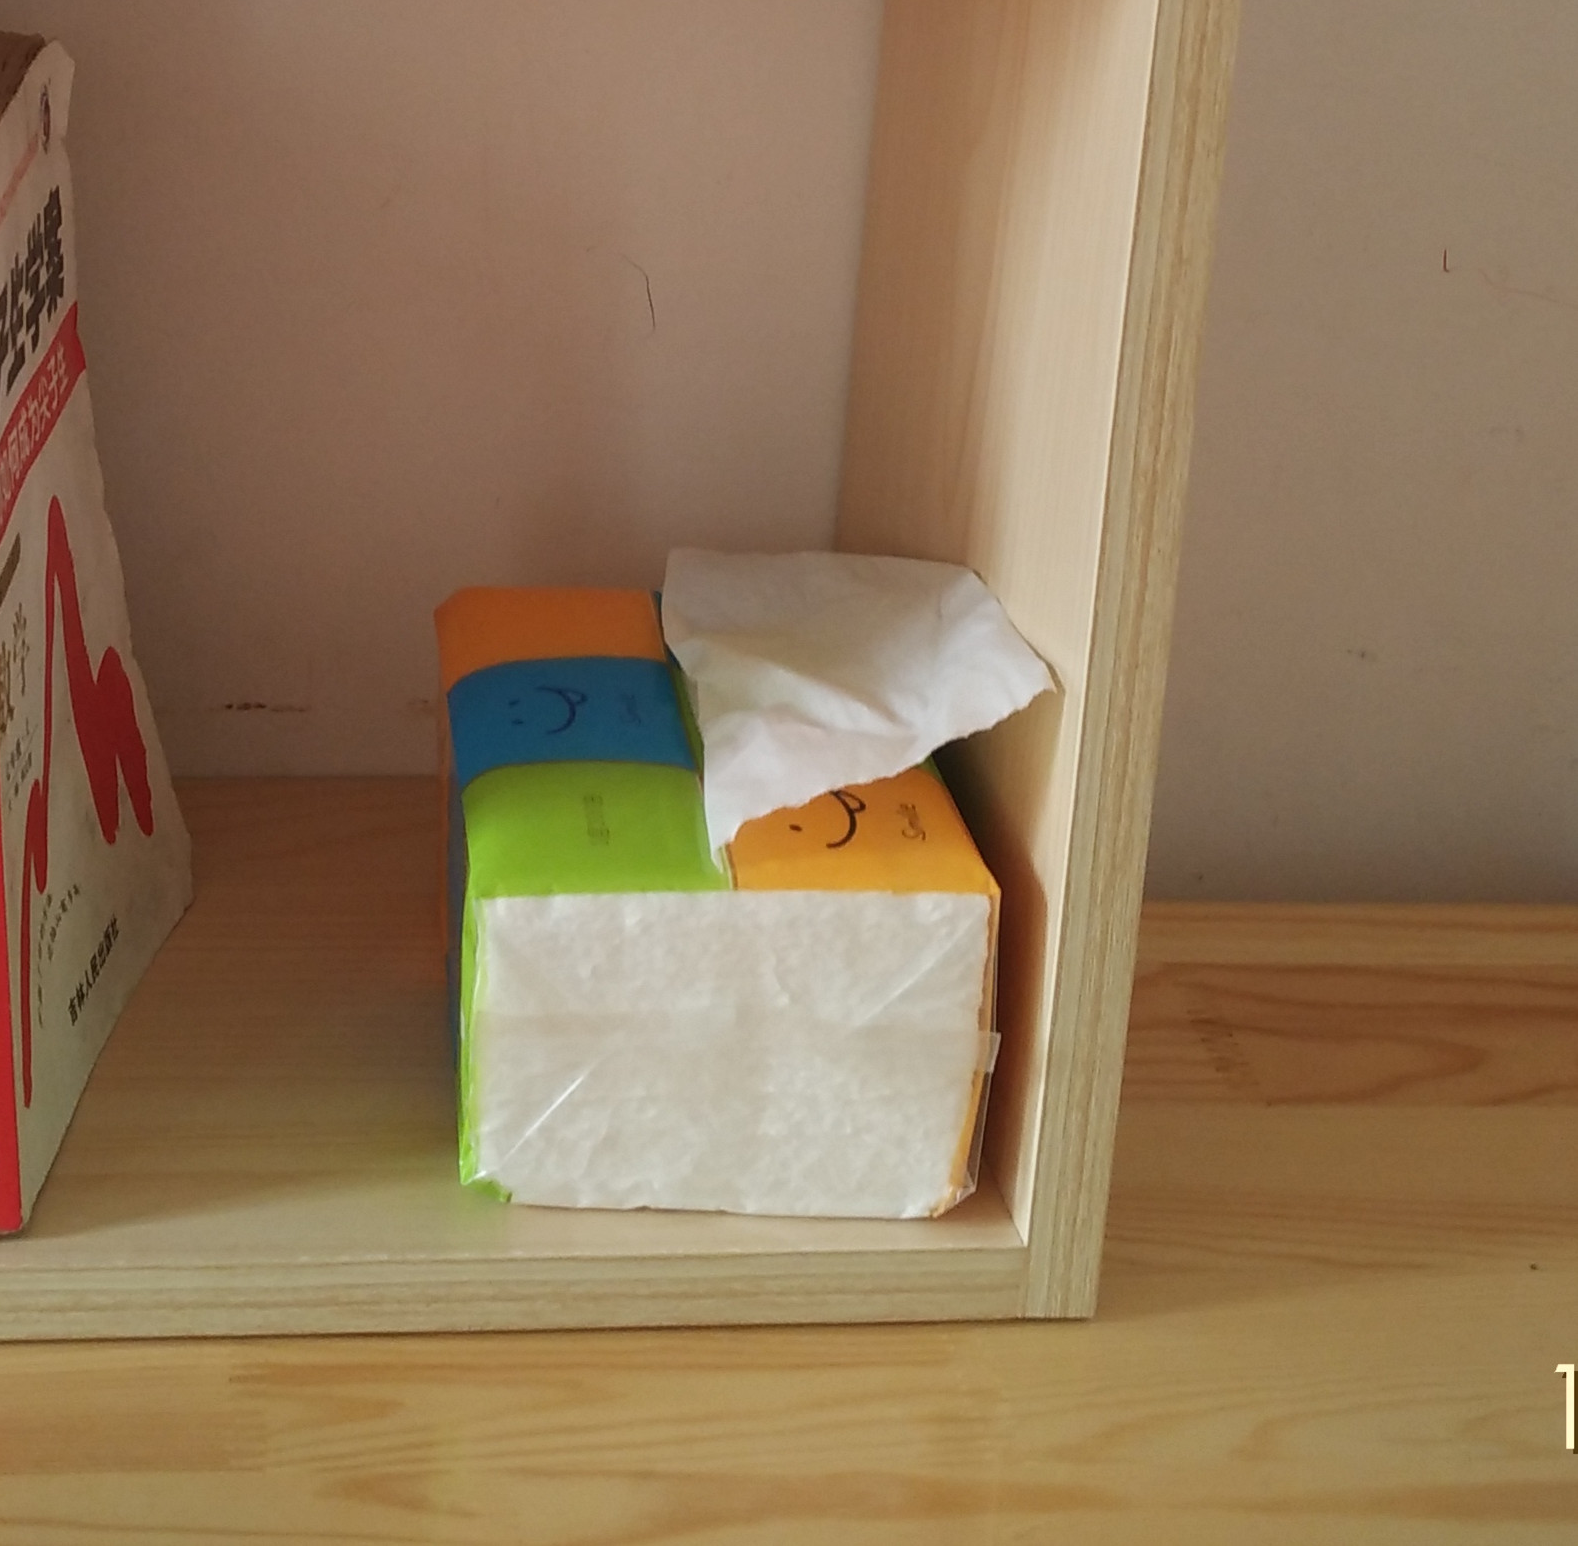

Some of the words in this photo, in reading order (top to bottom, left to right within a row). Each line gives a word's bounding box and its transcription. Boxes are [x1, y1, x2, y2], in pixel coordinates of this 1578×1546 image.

[67, 915, 120, 1027] 吉林人民出版社
